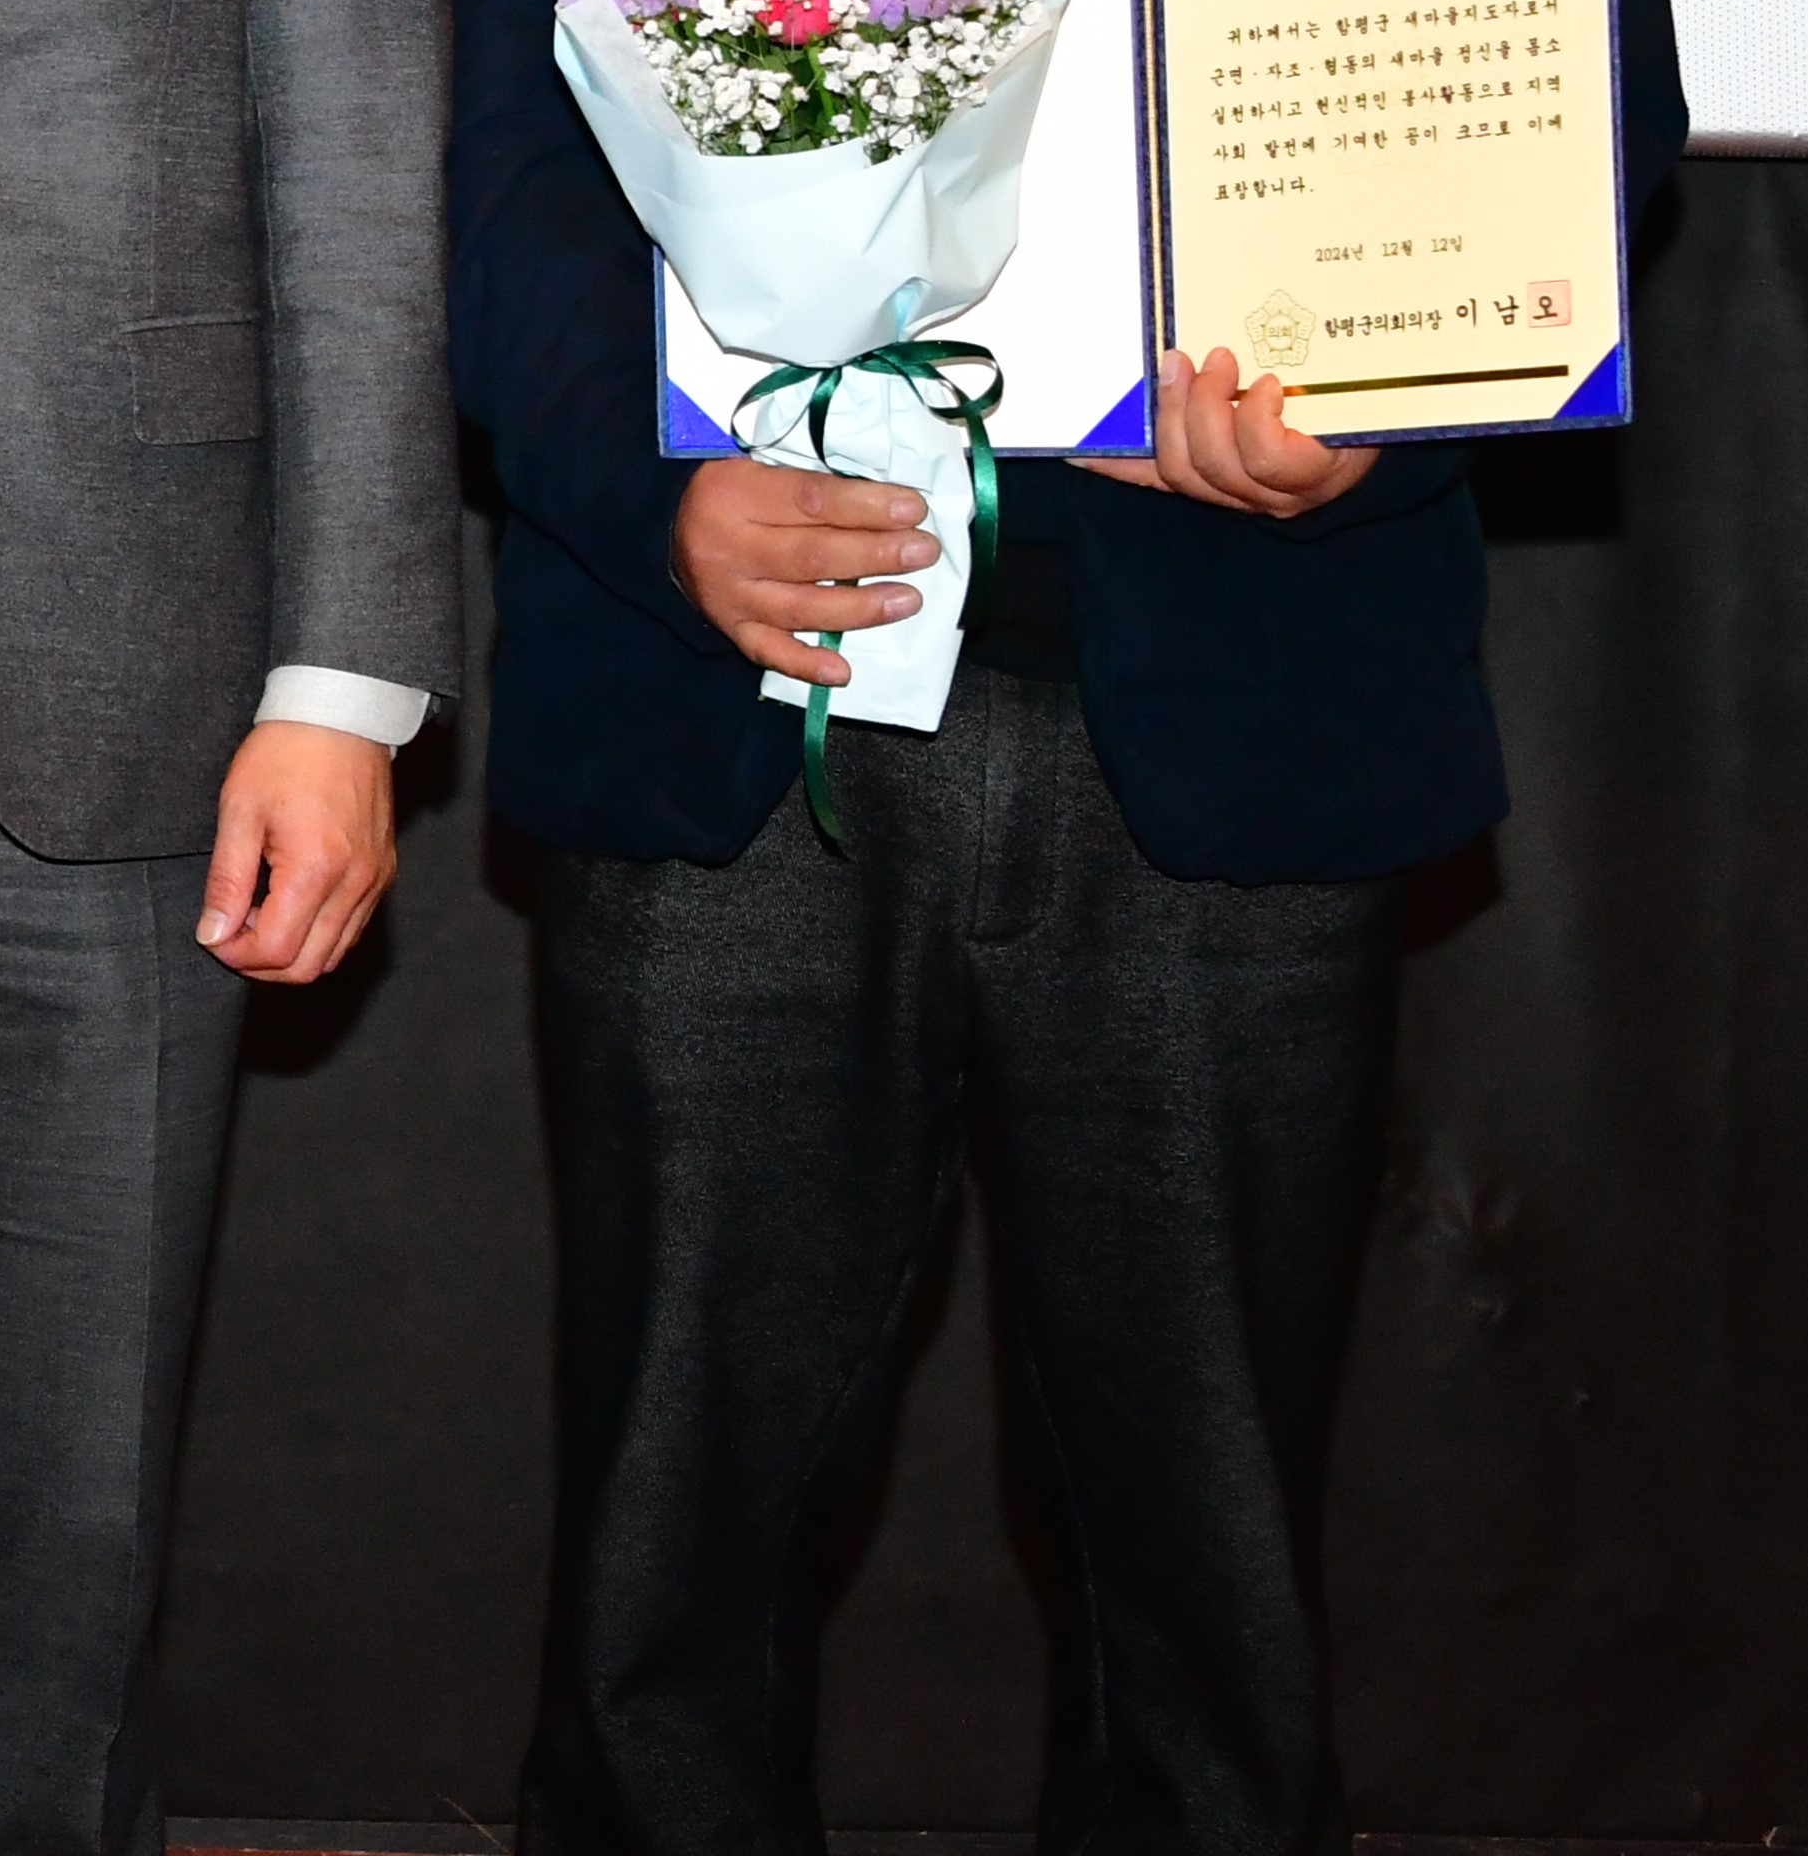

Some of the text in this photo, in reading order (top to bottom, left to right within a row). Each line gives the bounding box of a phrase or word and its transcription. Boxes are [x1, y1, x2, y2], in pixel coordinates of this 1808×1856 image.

[1335, 13, 1389, 36] 함평군
[1209, 65, 1242, 87] 근면
[1266, 62, 1301, 79] 자조
[1323, 53, 1375, 76] 협동의
[1389, 46, 1443, 67] 새마을
[1457, 39, 1511, 64] 정신을
[1315, 90, 1386, 115] 헌신적인
[1526, 74, 1560, 93] 지역
[1213, 142, 1245, 160] 사회
[1333, 129, 1387, 150] 기여한
[1404, 124, 1437, 146] 공이
[1455, 120, 1510, 139] 크므로
[1528, 113, 1561, 131] 이에
[1214, 175, 1313, 200] 표창합니다.
[1315, 235, 1462, 262] 2024년 12월 12일
[1324, 294, 1558, 338] 함평군의회의장 이 남 오
